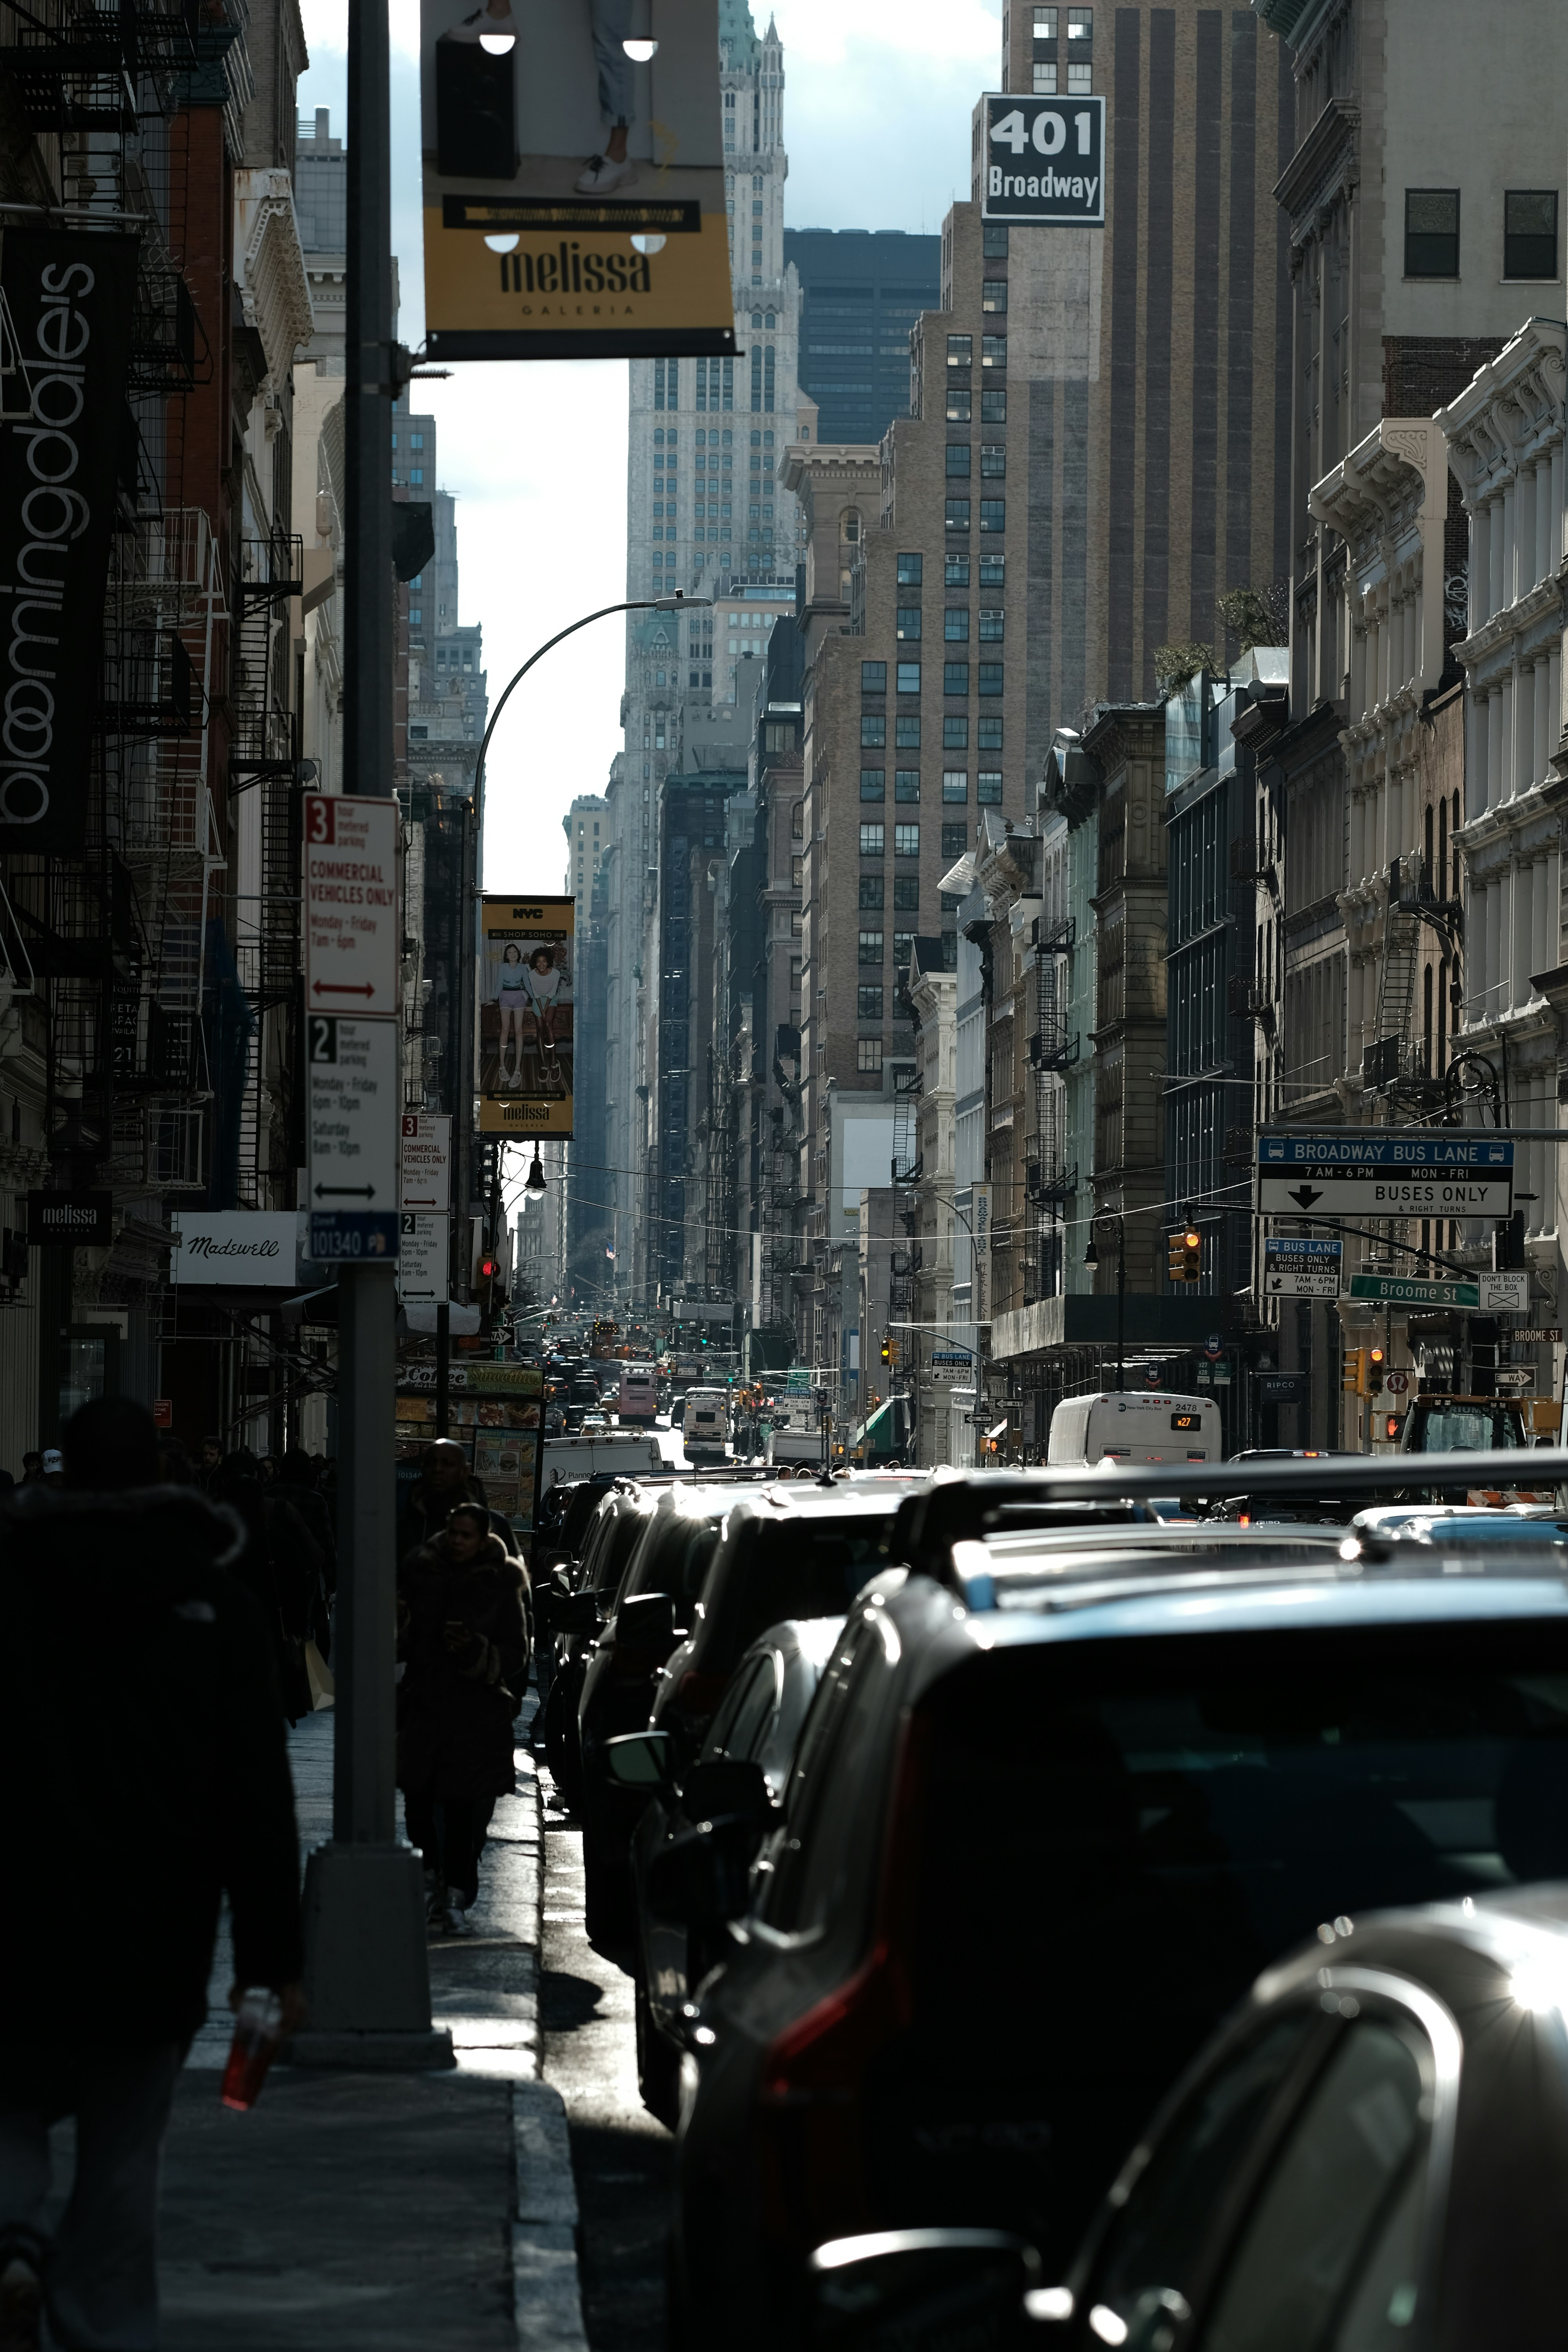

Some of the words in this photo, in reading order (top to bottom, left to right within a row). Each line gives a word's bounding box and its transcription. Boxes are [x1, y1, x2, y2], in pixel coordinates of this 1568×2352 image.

[990, 109, 1091, 155] 401
[989, 166, 1098, 207] Broadway
[501, 242, 651, 292] melissa
[523, 305, 634, 316] GALERIA
[311, 800, 328, 842] 3
[311, 861, 385, 883] COMMERCIAL
[310, 884, 363, 904] VEHICLES
[366, 889, 394, 907] ONLY
[513, 909, 543, 919] NYC
[311, 915, 342, 931] Monday
[351, 916, 377, 934] Friday
[314, 1019, 329, 1060] 2
[352, 1078, 377, 1095] Friday
[504, 1104, 549, 1120] melissa
[406, 1117, 414, 1135] 3
[404, 1144, 441, 1153] COMMERCIAL
[1295, 1144, 1385, 1160] BROADWAY
[1394, 1146, 1426, 1160] BUS
[1434, 1146, 1478, 1161] LANE
[404, 1155, 430, 1163] VEHICLES
[432, 1155, 446, 1164] ONLY
[1305, 1167, 1312, 1176] 7
[1316, 1167, 1333, 1177] AM
[1346, 1168, 1353, 1177] 6
[1357, 1168, 1374, 1178] PM
[1411, 1168, 1437, 1178] MON
[1450, 1169, 1468, 1179] FRI
[1376, 1186, 1434, 1201] BUSES
[1443, 1187, 1488, 1201] ONLY
[43, 1204, 97, 1224] melissa
[404, 1214, 412, 1232] 2
[188, 1237, 279, 1258] Madewell
[312, 1230, 362, 1256] 101340
[977, 1223, 987, 1256] ELETRONIC
[1284, 1242, 1305, 1252] BUS
[1309, 1243, 1338, 1253] LANE
[1276, 1254, 1304, 1262] BUSES
[1307, 1265, 1336, 1274] TURNS
[1380, 1282, 1437, 1299] Broome
[1443, 1287, 1456, 1301] St
[1515, 1330, 1546, 1341] BROOME
[1550, 1330, 1559, 1341] ST
[408, 1368, 465, 1383] Cofee
[469, 1366, 541, 1385] Smoothies
[397, 1403, 426, 1414] Waffle
